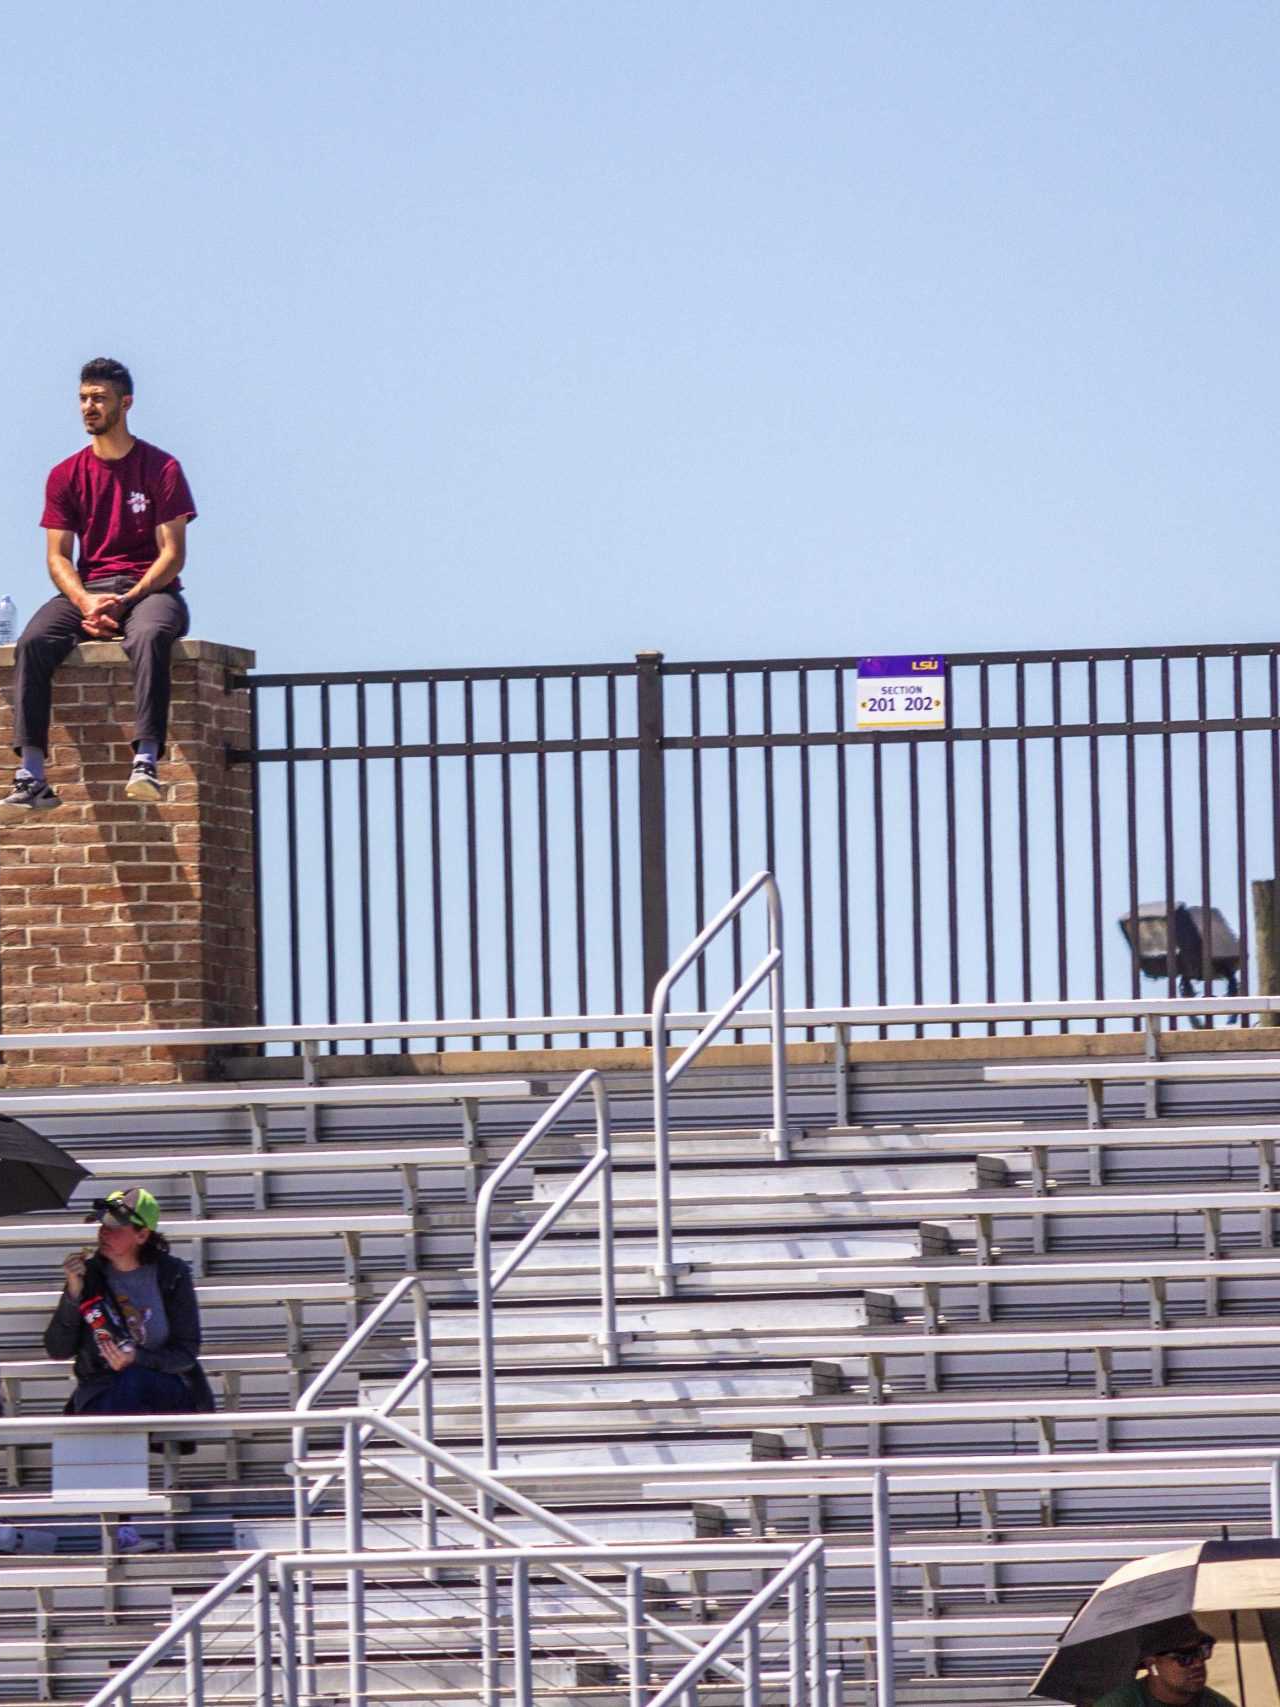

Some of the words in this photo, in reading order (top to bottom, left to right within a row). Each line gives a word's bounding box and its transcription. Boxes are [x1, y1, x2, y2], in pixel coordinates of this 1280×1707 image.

[911, 660, 939, 671] LSU
[880, 686, 923, 696] SECTION
[868, 698, 896, 712] 201
[904, 697, 933, 711] 202
